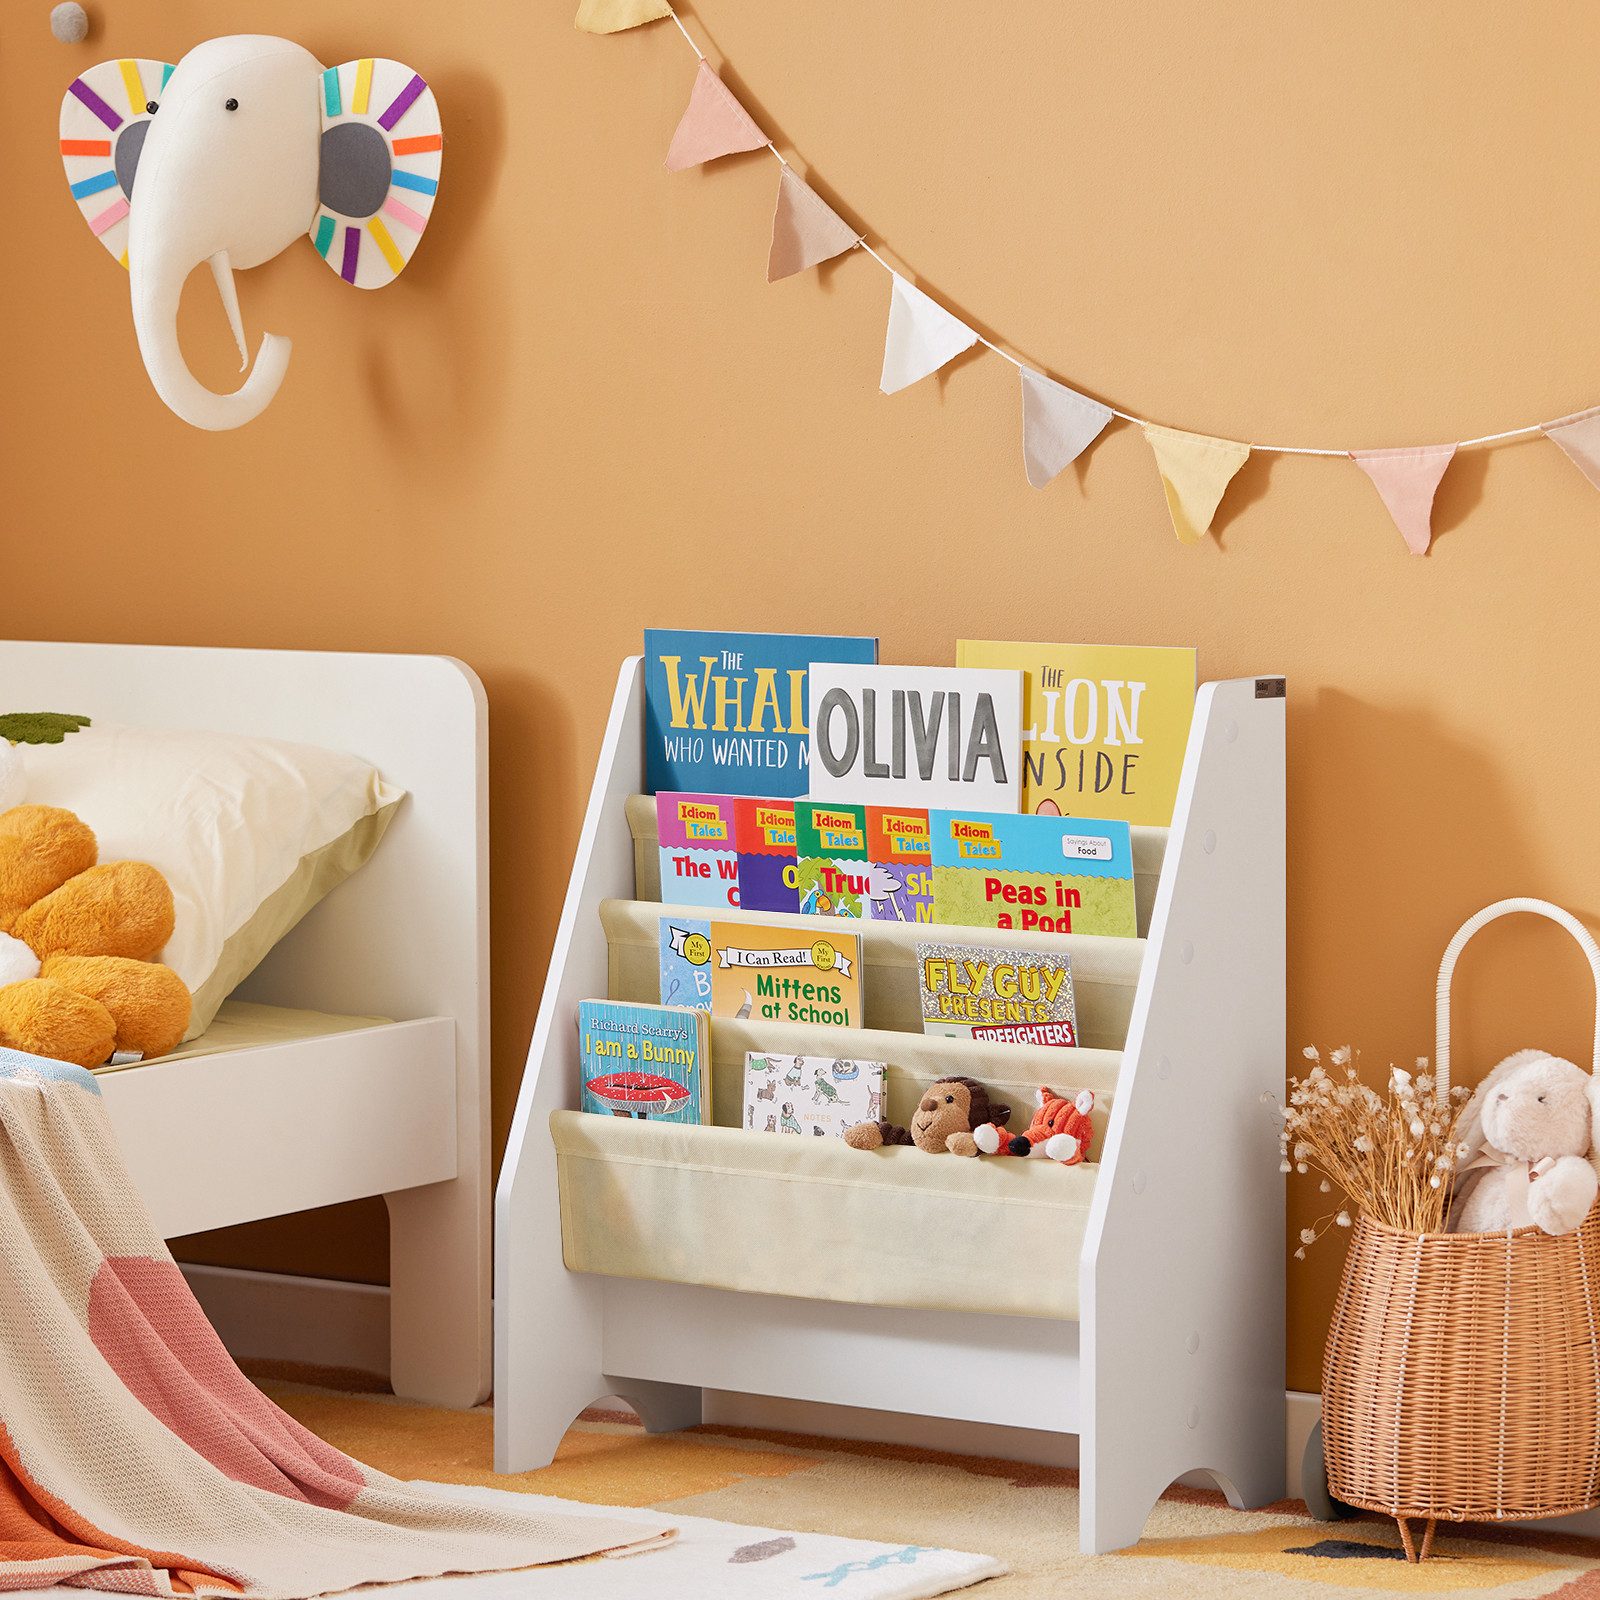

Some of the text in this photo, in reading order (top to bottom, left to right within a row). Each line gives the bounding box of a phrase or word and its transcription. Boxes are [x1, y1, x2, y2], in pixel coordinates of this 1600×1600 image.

[721, 651, 744, 671] THE
[1041, 665, 1065, 688] THE
[816, 687, 1008, 784] OLIVIA
[664, 736, 704, 763] WHO
[712, 738, 788, 769] WANTED
[681, 805, 716, 820] Idiom
[760, 812, 795, 826] Idiom
[815, 814, 852, 829] Idiom
[886, 818, 923, 834] Idiom
[690, 823, 723, 837] Tales
[954, 823, 990, 839] Idiom
[825, 832, 859, 846] Tales
[896, 837, 930, 851] Tales
[963, 842, 997, 856] Tales
[1077, 846, 1097, 855] Food
[672, 855, 711, 878] The
[984, 877, 1082, 908] Peas in
[997, 909, 1073, 934] a Pod
[689, 949, 706, 957] First
[690, 941, 704, 950] My
[817, 947, 828, 956] My
[737, 951, 807, 965] I Can Read!
[925, 957, 1067, 1004] FLY GUY
[756, 974, 842, 1004] Mittens
[762, 1002, 850, 1026] at School
[938, 993, 1050, 1023] PRESENTS
[590, 1018, 688, 1040] Richard Scarry's
[585, 1033, 695, 1073] I am a Bunny
[803, 1113, 832, 1122] NOTES
